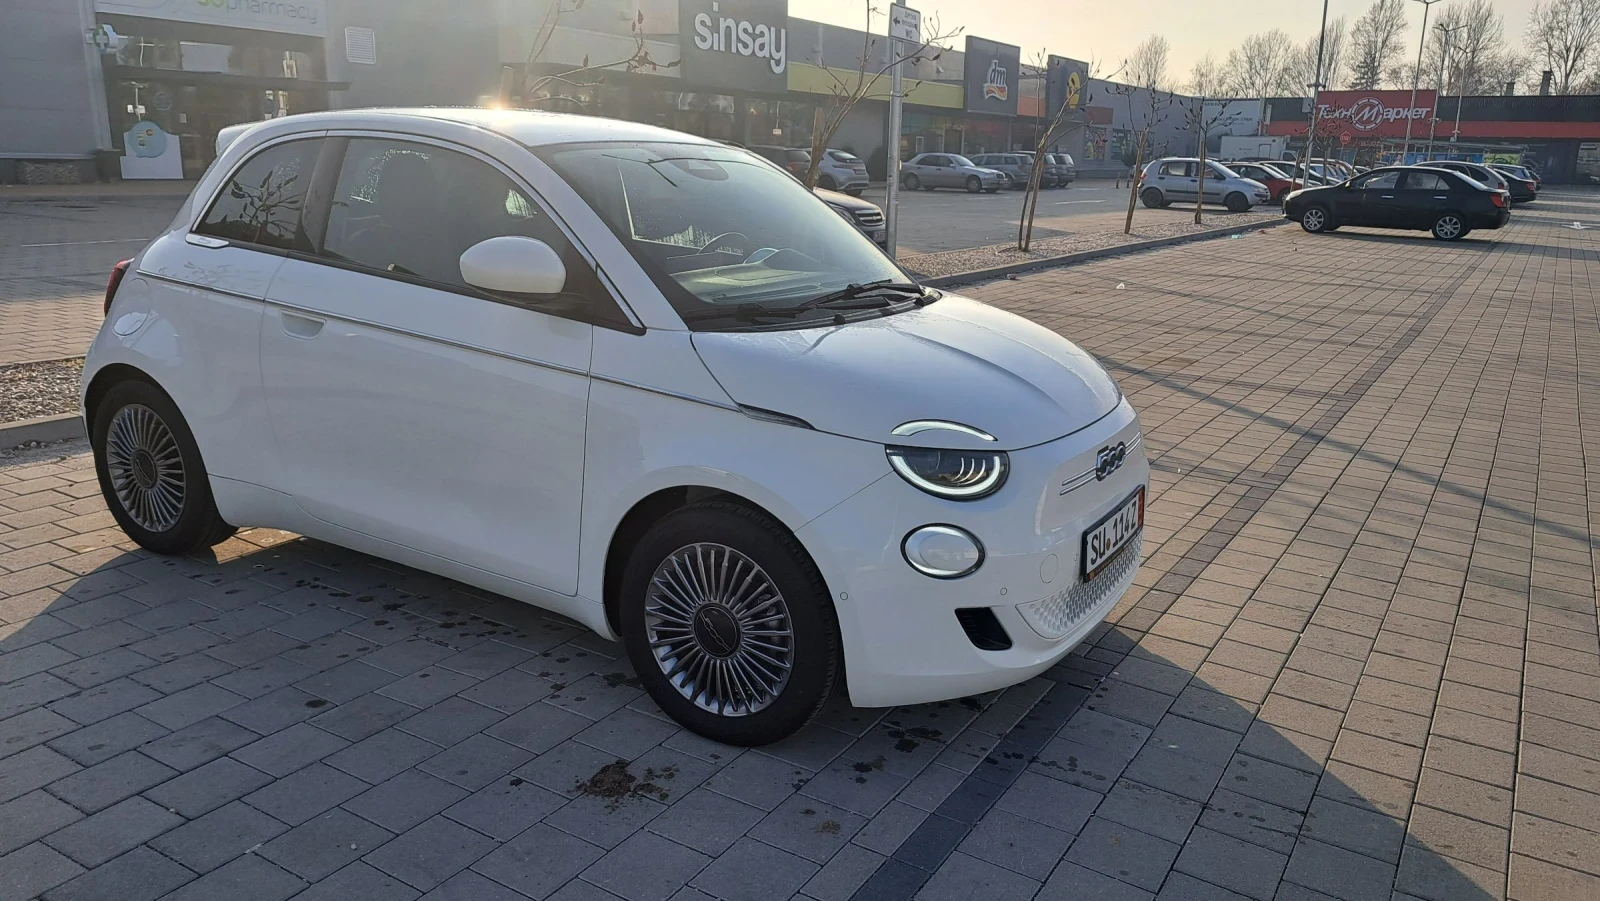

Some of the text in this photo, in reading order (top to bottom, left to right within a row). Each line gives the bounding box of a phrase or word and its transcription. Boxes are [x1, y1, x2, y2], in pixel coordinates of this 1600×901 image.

[694, 2, 786, 74] sinsay
[988, 60, 1006, 86] dm
[1090, 527, 1106, 566] SU
